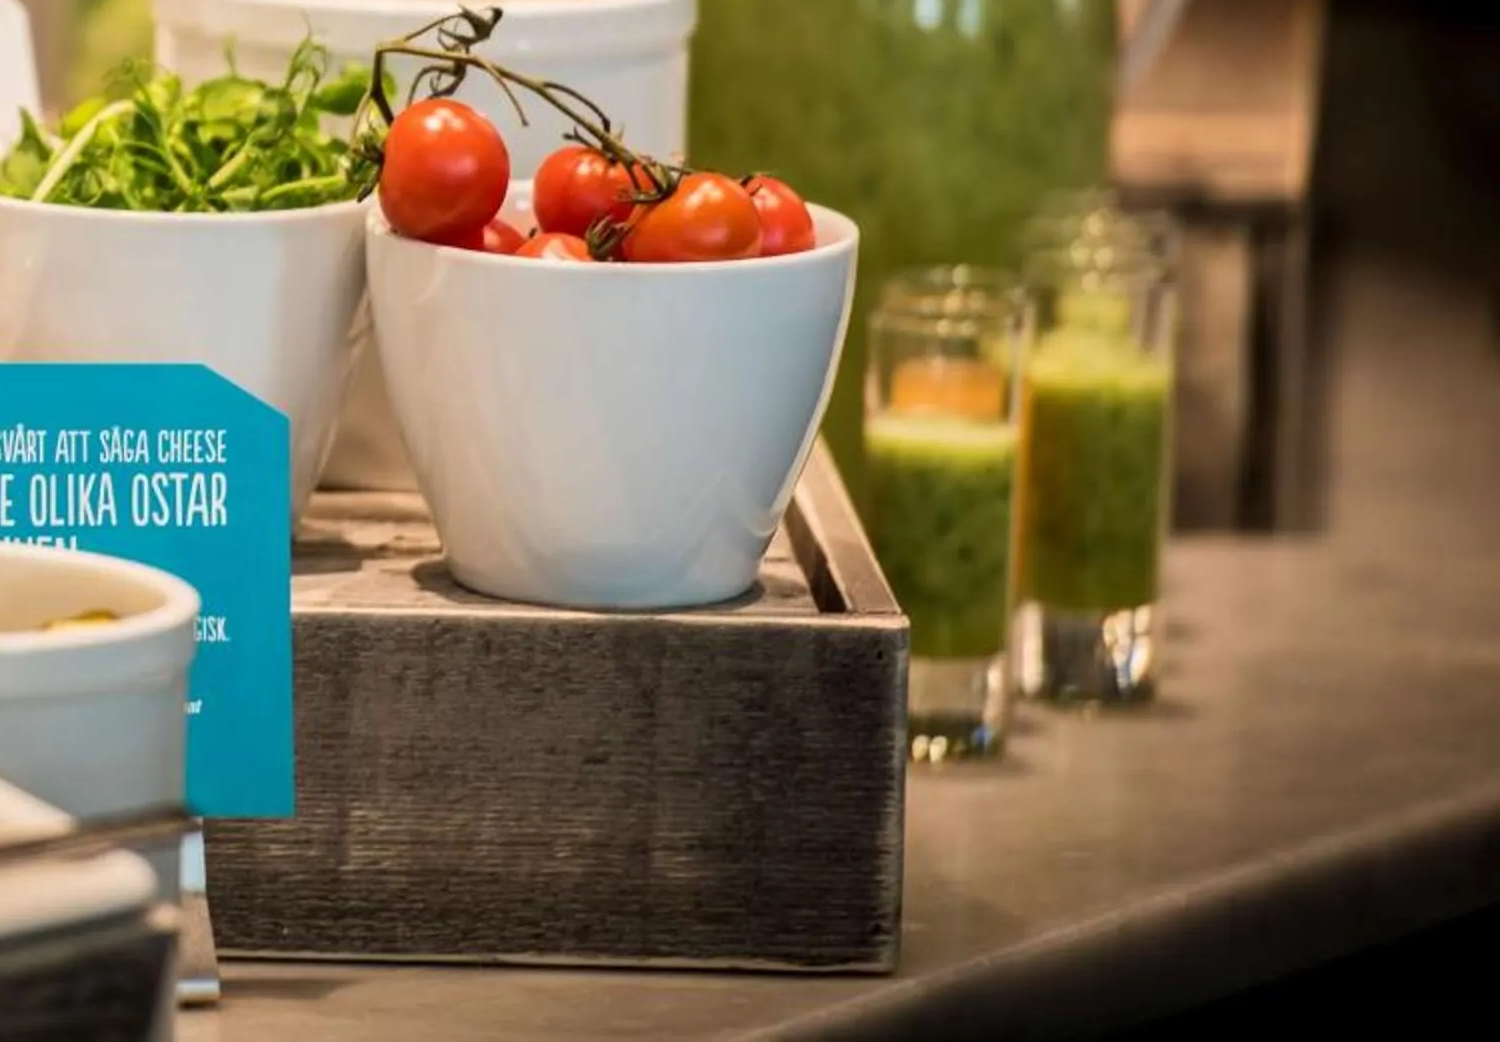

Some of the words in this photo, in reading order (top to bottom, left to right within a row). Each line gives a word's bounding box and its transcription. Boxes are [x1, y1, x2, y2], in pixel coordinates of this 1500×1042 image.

[55, 429, 90, 463] ATT
[157, 429, 226, 464] CHEESE
[29, 472, 117, 527] OLIKA
[131, 472, 227, 527] OSTAR
